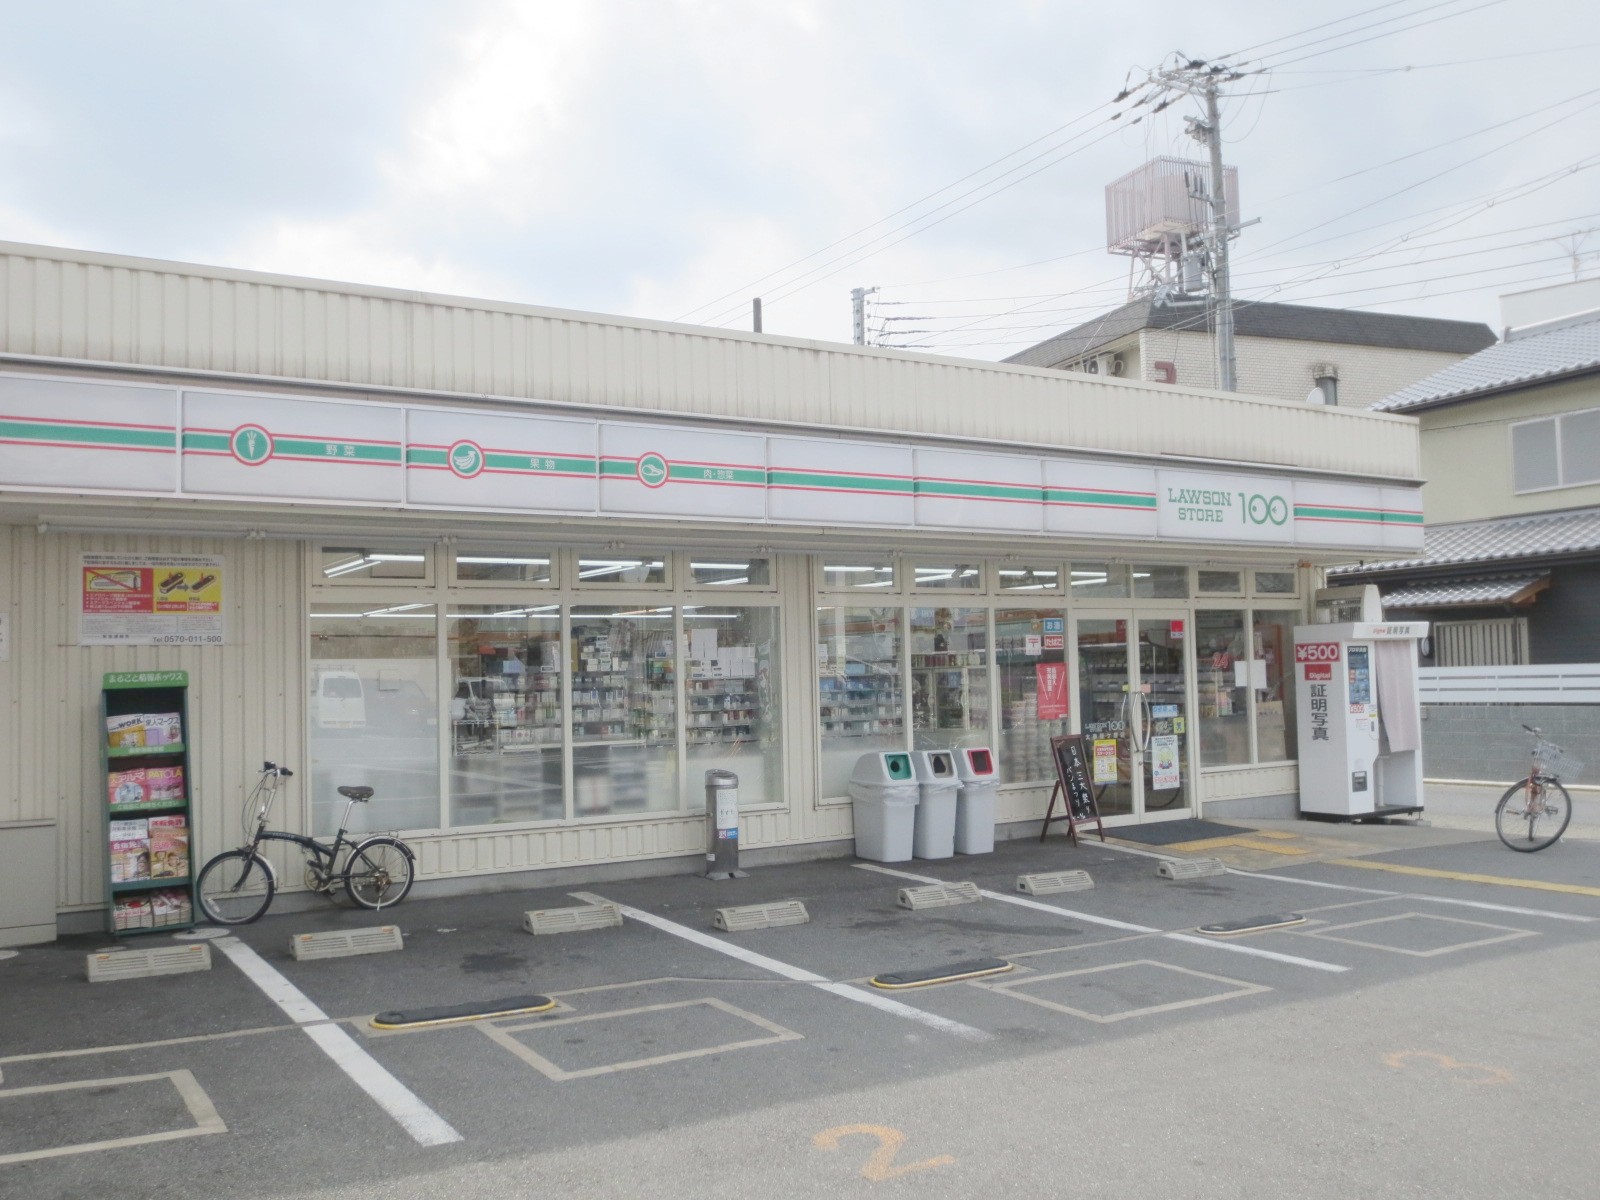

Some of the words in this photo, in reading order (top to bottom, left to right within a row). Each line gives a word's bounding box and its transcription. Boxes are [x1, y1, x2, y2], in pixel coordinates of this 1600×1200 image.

[325, 442, 356, 458] 野菜
[529, 457, 556, 470] 果物
[1168, 488, 1232, 507] LAWSON
[1178, 508, 1223, 522] STORE
[1238, 492, 1288, 526] 100
[1046, 621, 1061, 630] お酒
[164, 635, 222, 643] 0570-011-500
[1046, 638, 1063, 647] たばこ
[1297, 645, 1338, 660] ¥500
[1309, 672, 1331, 681] Digital
[1310, 684, 1329, 741] 証明写真
[118, 717, 143, 728] WORK
[148, 769, 183, 779] PATOLA
[811, 1123, 956, 1182] 2
